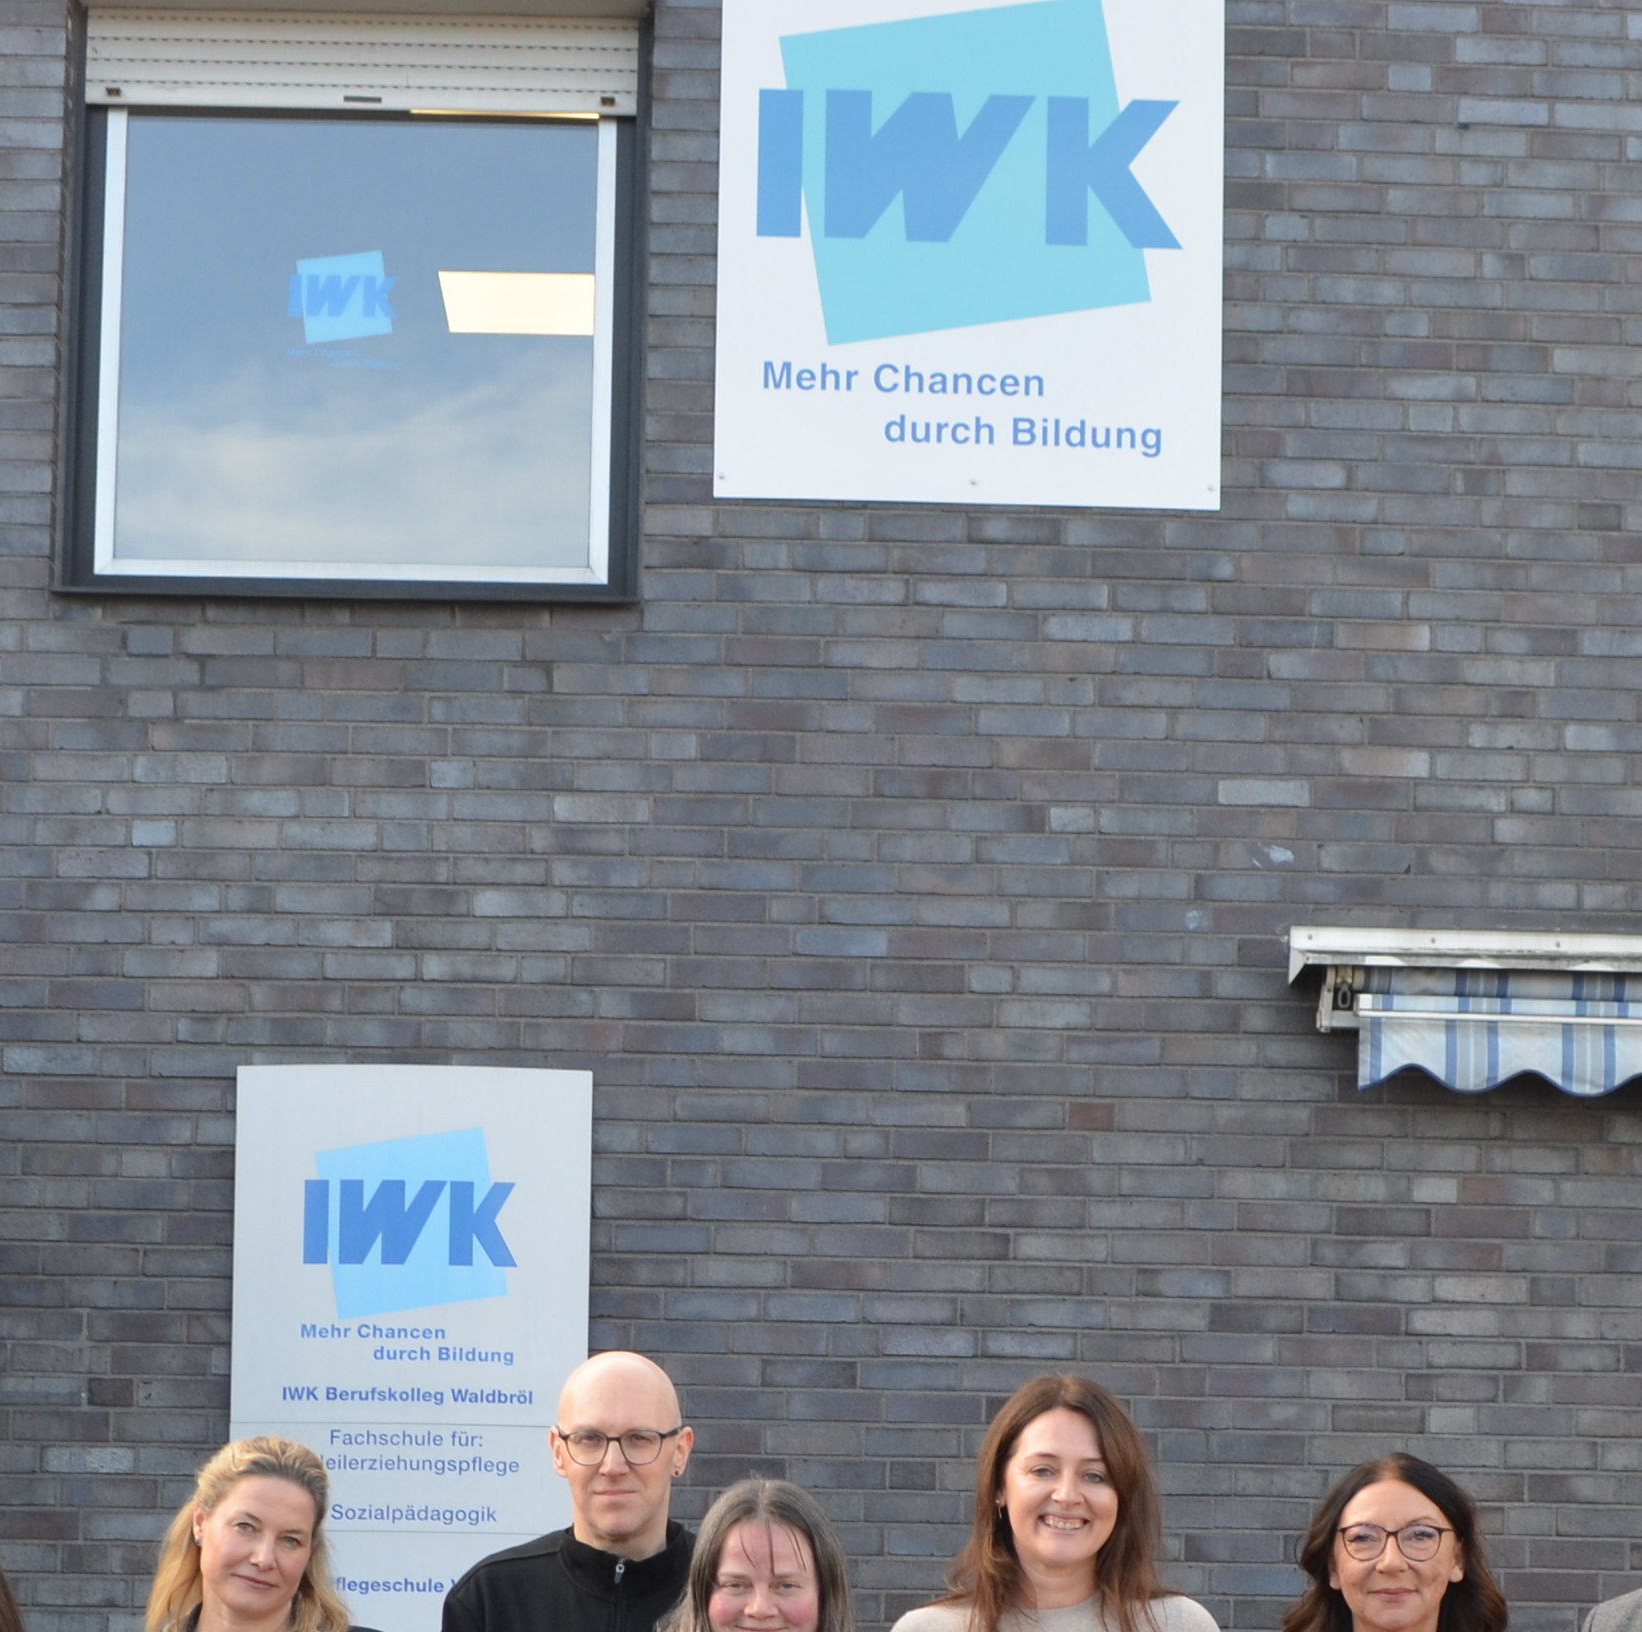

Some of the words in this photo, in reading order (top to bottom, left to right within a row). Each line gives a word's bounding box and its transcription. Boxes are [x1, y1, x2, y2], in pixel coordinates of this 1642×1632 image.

[756, 88, 1183, 250] IWK
[287, 274, 399, 319] IWK
[761, 359, 859, 391] Mehr
[872, 362, 1046, 397] Chancen
[883, 413, 996, 445] durch
[1010, 415, 1164, 458] Bildung
[302, 1179, 518, 1268] IWK
[300, 1323, 351, 1339] Mehr
[356, 1323, 447, 1340] Chancen
[373, 1345, 431, 1362] durch
[437, 1346, 515, 1366] Bildung
[281, 1386, 319, 1402] IWK
[325, 1386, 445, 1406] Berufskolleg
[451, 1387, 534, 1405] Waldbröl
[329, 1429, 444, 1447] Fachschule
[450, 1430, 484, 1448] für:
[322, 1454, 520, 1477] eilerziehungspflege
[330, 1503, 498, 1526] Sozialpädagogik
[336, 1576, 445, 1595] flegeschule
